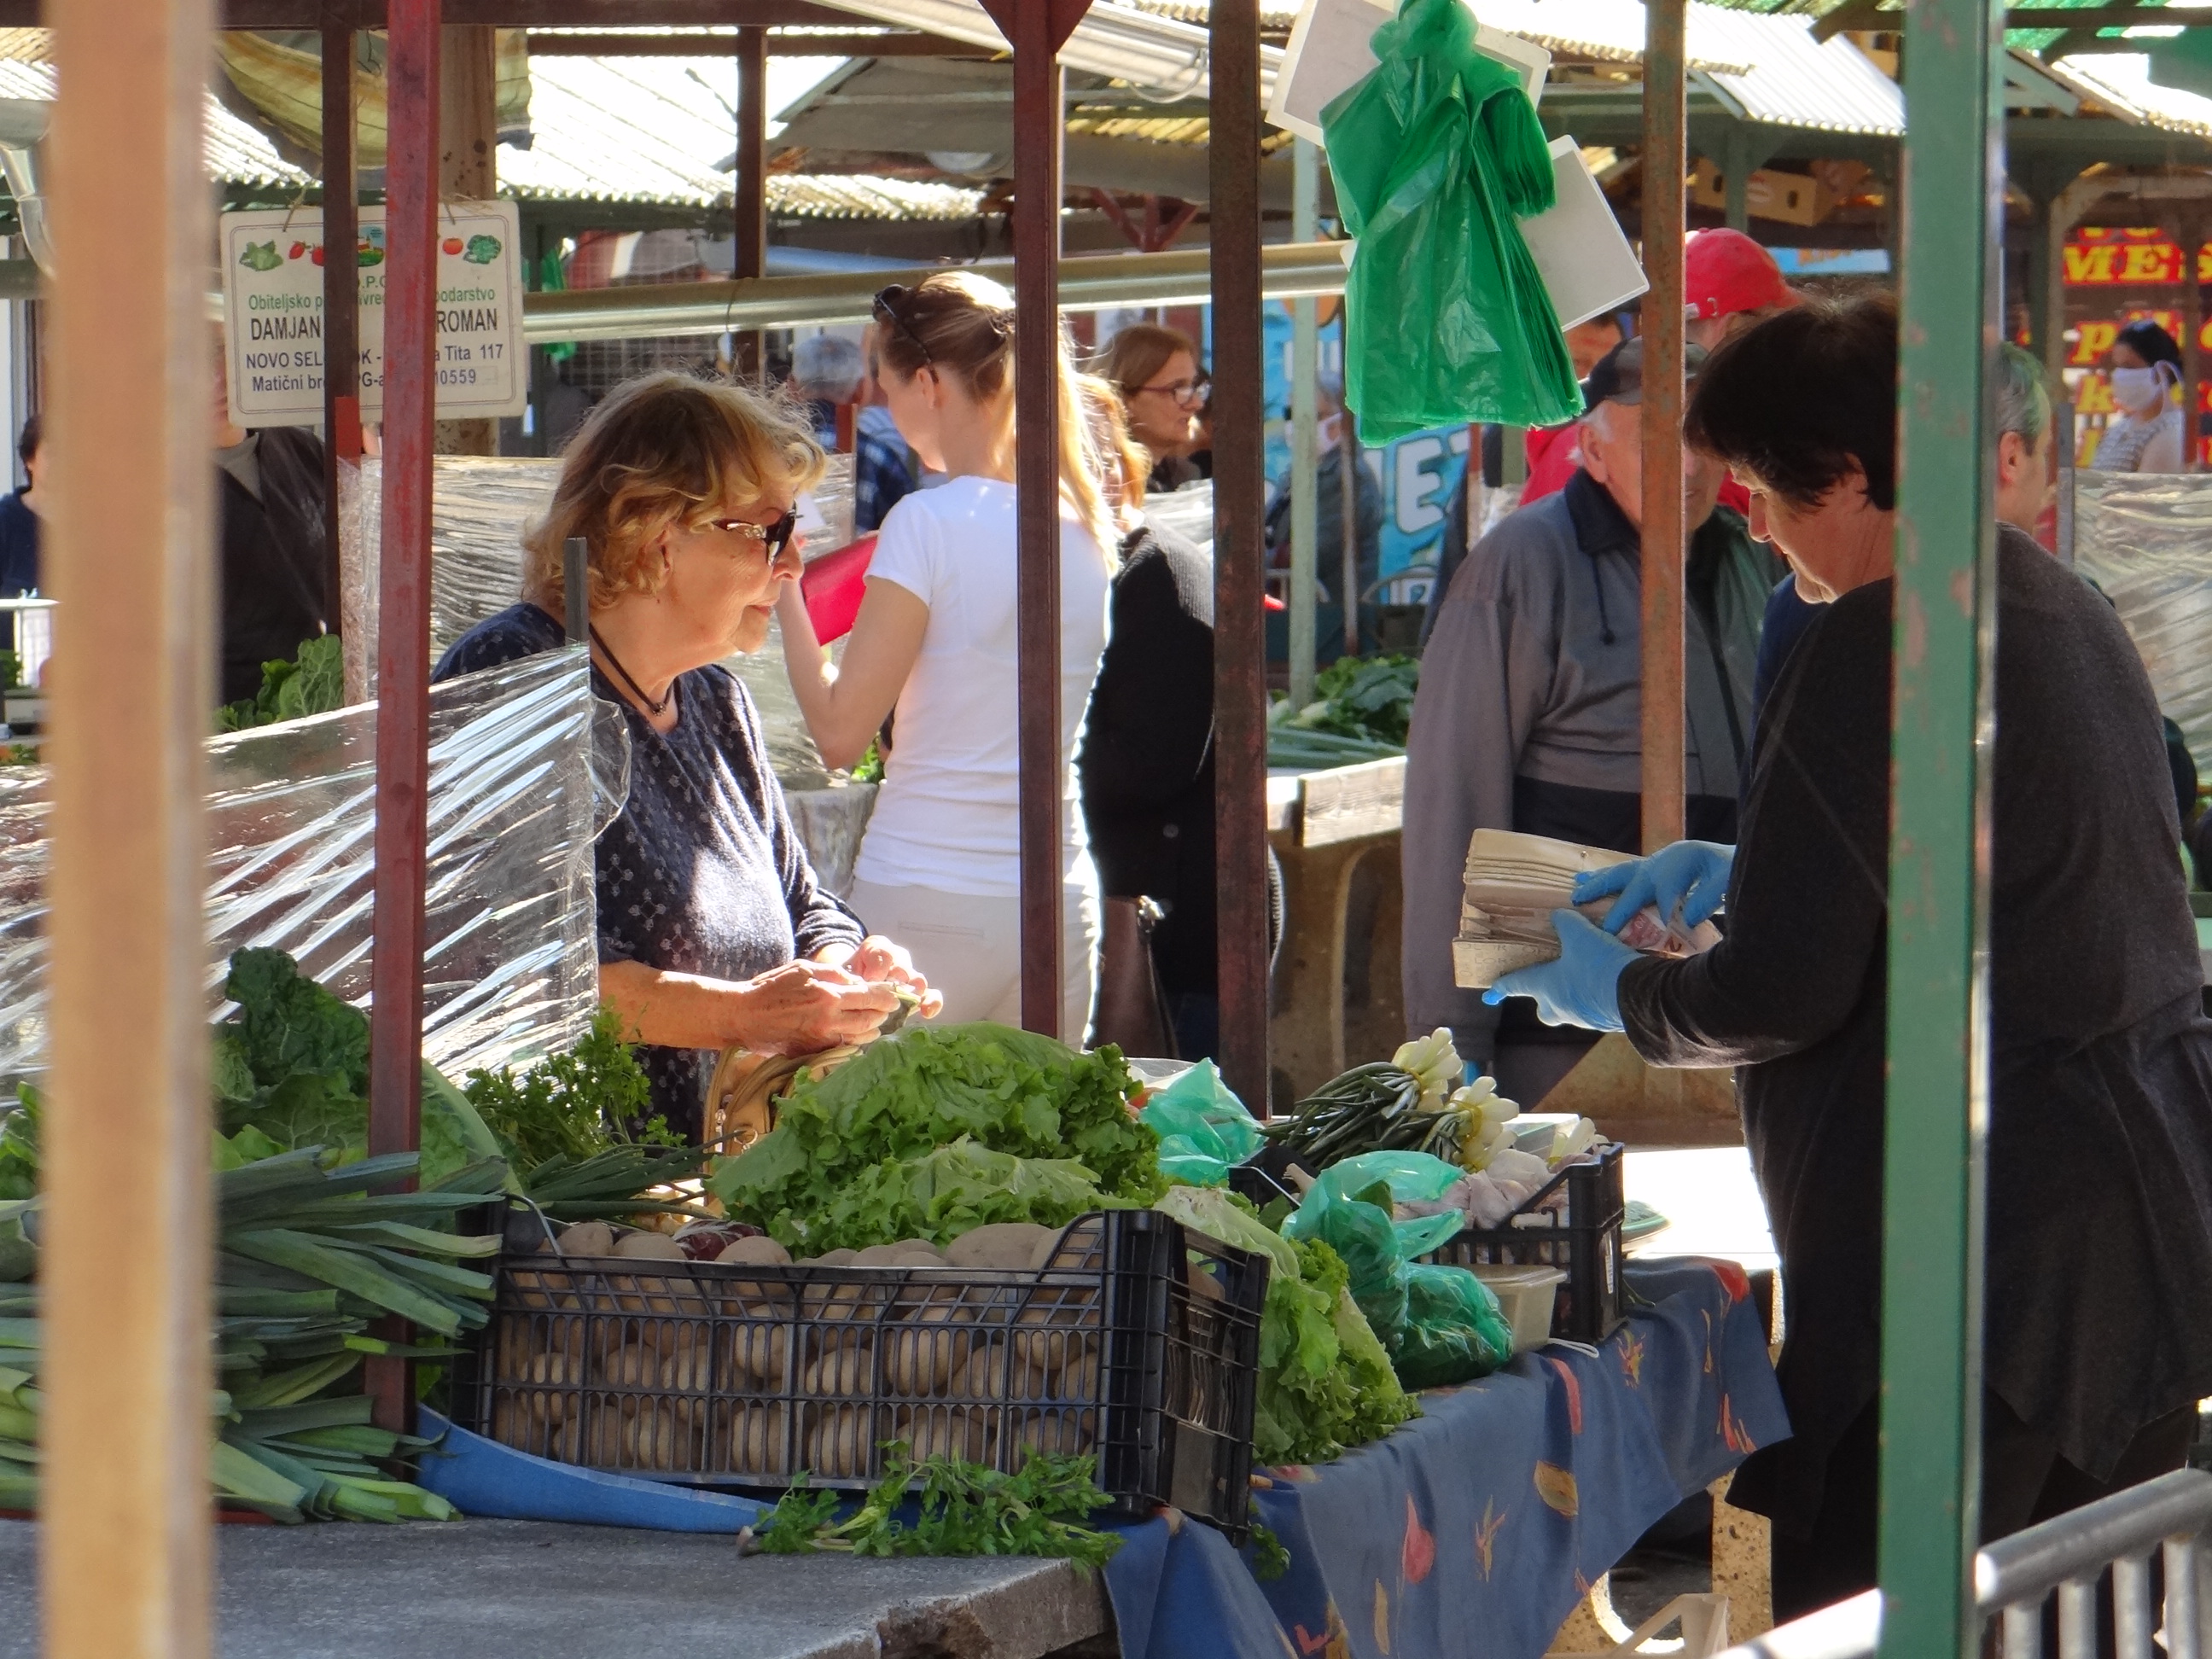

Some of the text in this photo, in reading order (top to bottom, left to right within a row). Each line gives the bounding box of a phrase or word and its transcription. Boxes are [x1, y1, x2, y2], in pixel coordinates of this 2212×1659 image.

[248, 293, 311, 312] Obiteljsko
[250, 308, 498, 341] DAMJAN ROMAN
[246, 352, 289, 369] NOVO
[294, 351, 323, 367] SEL
[444, 345, 471, 360] Tita
[480, 343, 504, 359] 117
[253, 375, 303, 392] Matični
